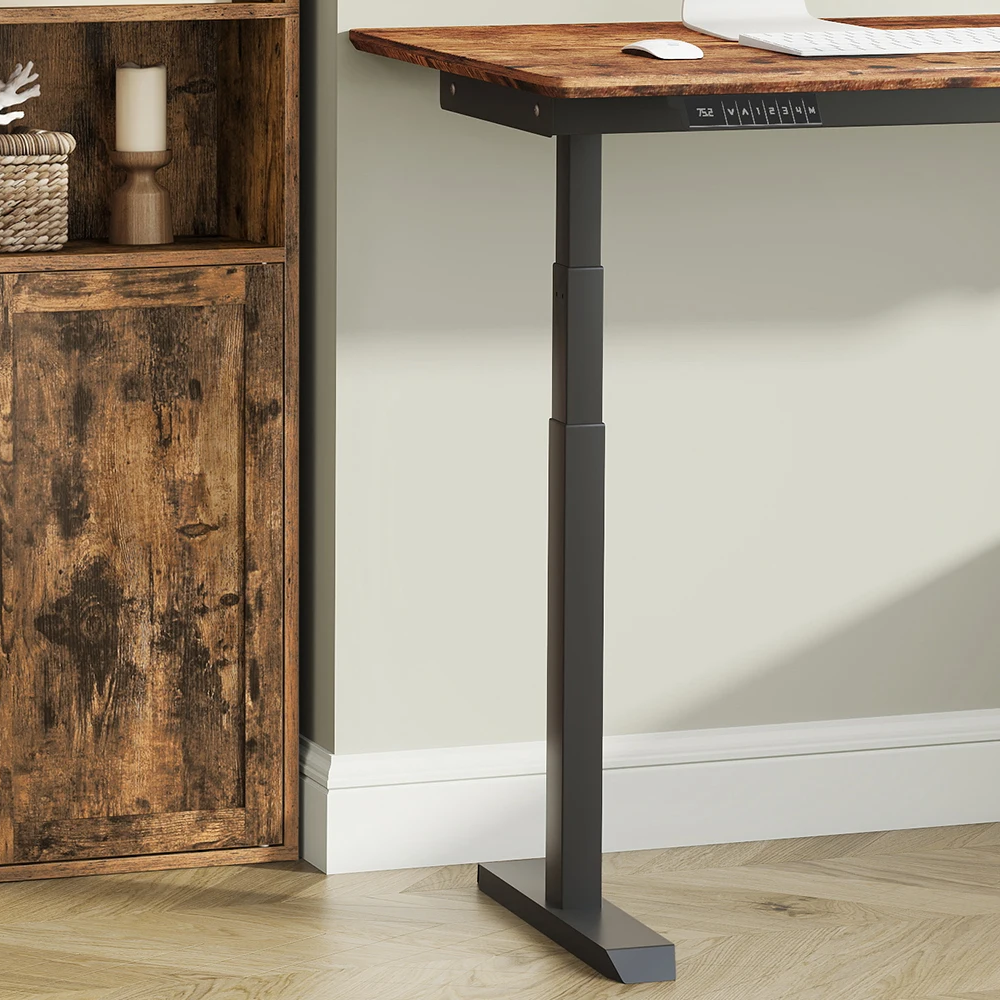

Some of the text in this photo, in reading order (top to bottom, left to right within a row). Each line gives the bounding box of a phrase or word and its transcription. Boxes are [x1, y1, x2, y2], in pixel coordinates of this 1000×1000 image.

[768, 106, 776, 115] 2
[782, 106, 789, 115] 3
[795, 106, 802, 115] 4
